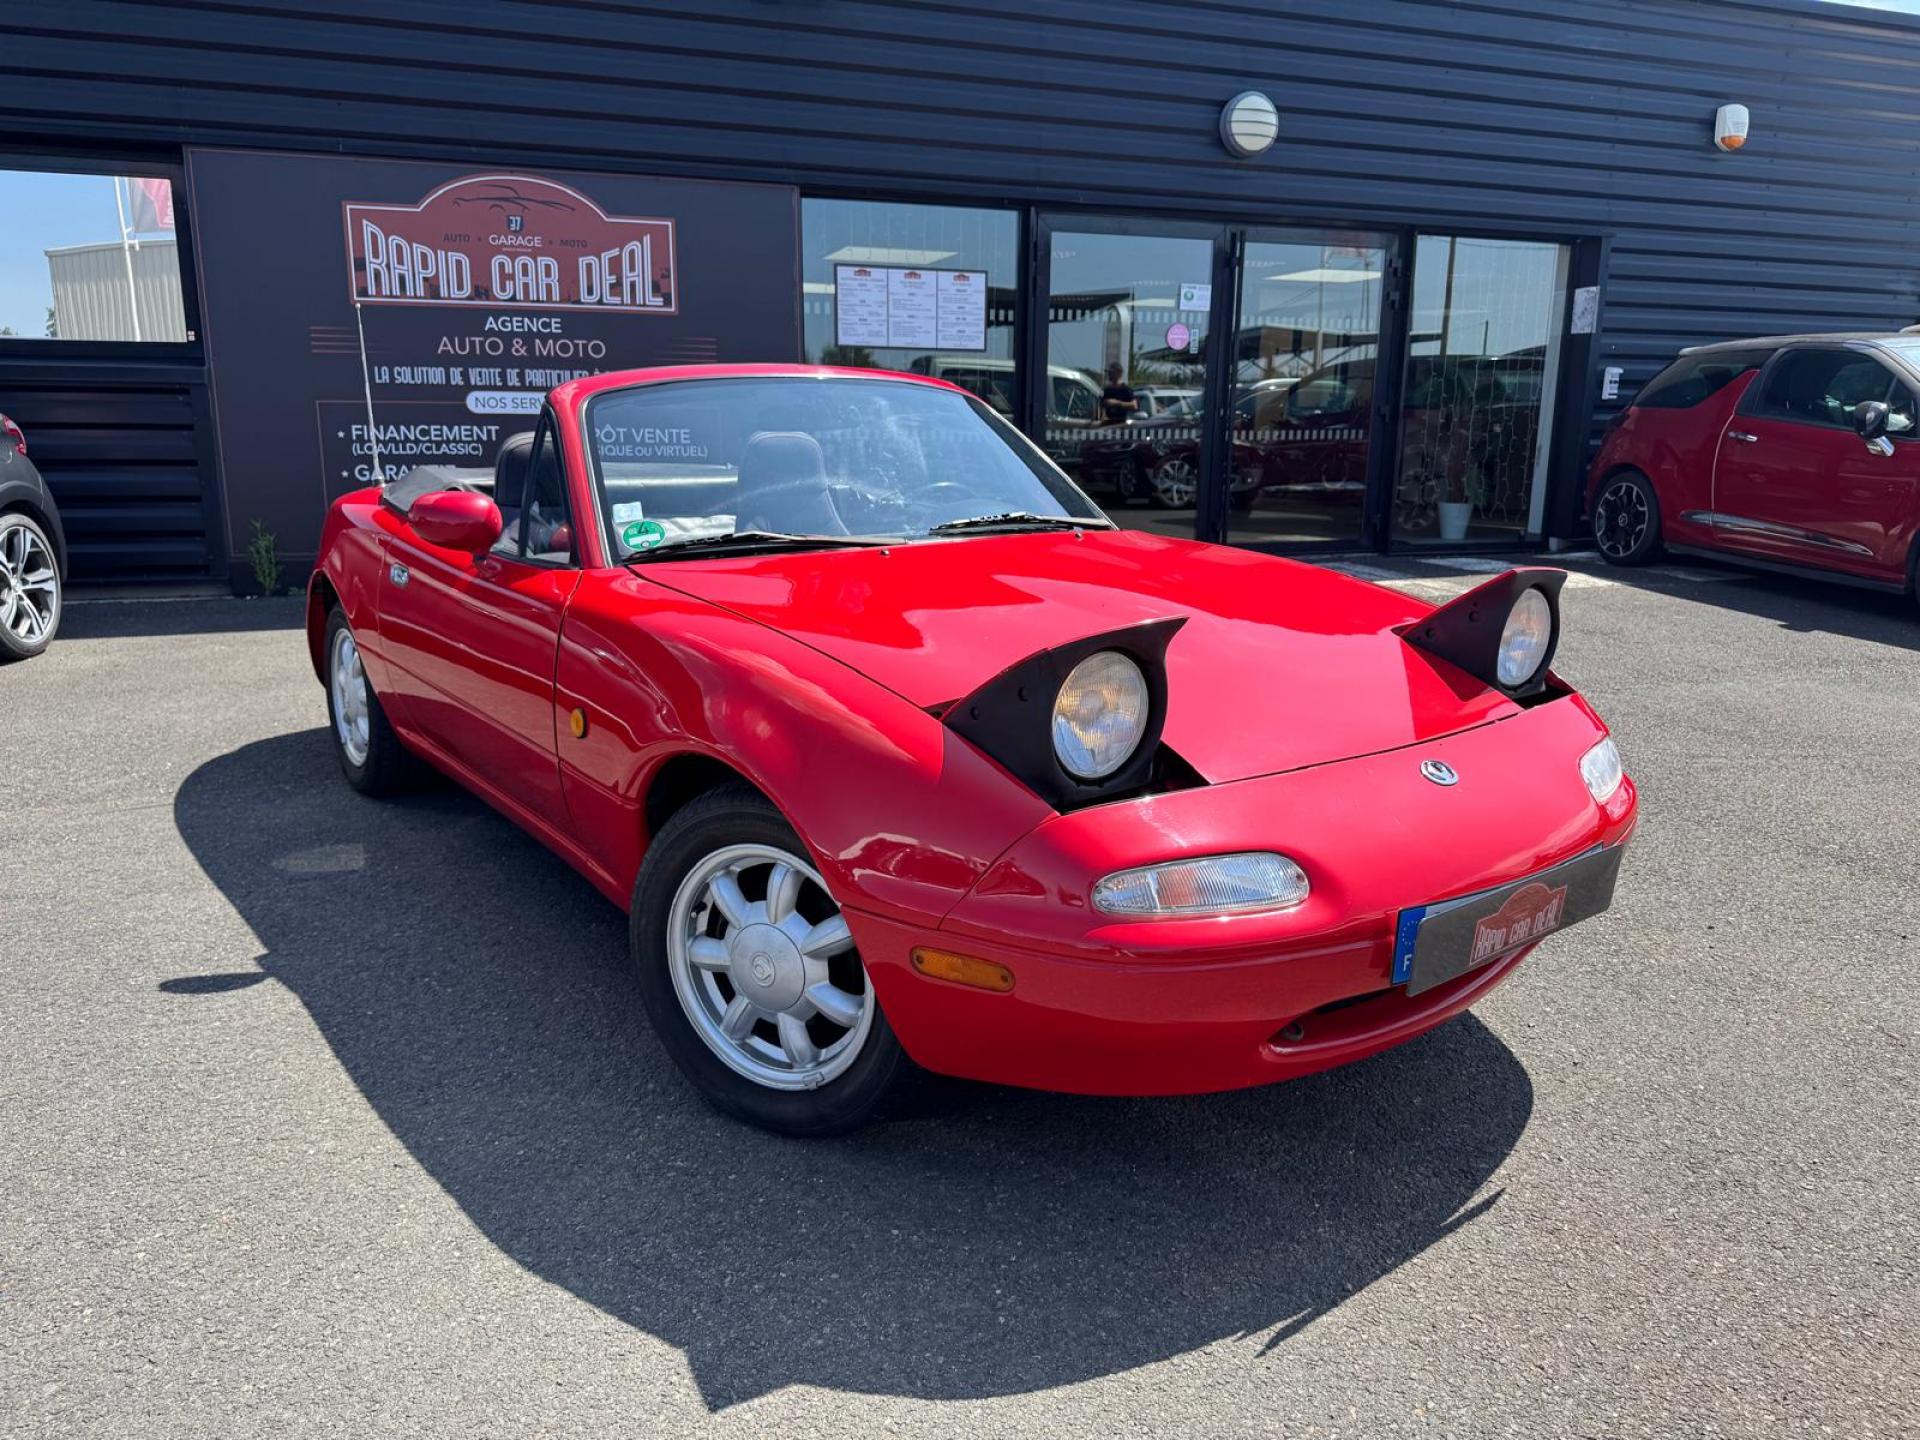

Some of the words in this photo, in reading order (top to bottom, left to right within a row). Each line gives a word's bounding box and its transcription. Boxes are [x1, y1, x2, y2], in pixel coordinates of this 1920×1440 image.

[509, 216, 521, 231] 37
[443, 233, 470, 243] AUTO
[488, 234, 543, 247] GARAGE
[559, 239, 588, 249] MOTO
[362, 219, 471, 298] RAPID
[491, 254, 560, 302] CAR
[578, 233, 664, 306] DEAL
[484, 316, 562, 333] AGENCE
[437, 336, 504, 356] AUTO
[511, 338, 527, 356] &
[535, 339, 606, 359] MOTO
[374, 366, 390, 384] LA
[394, 366, 446, 385] SOLUTION
[450, 367, 464, 385] DE
[468, 368, 503, 386] VENTE
[506, 368, 521, 387] DE
[474, 396, 507, 409] NOS
[351, 425, 500, 441] FINANCEMENT
[631, 428, 691, 444] VENTE
[653, 445, 708, 458] VIRTUEL)
[1473, 924, 1507, 960] RAPID
[1509, 917, 1531, 944] CAR
[1532, 893, 1561, 935] DEAL
[1403, 953, 1412, 971] F
